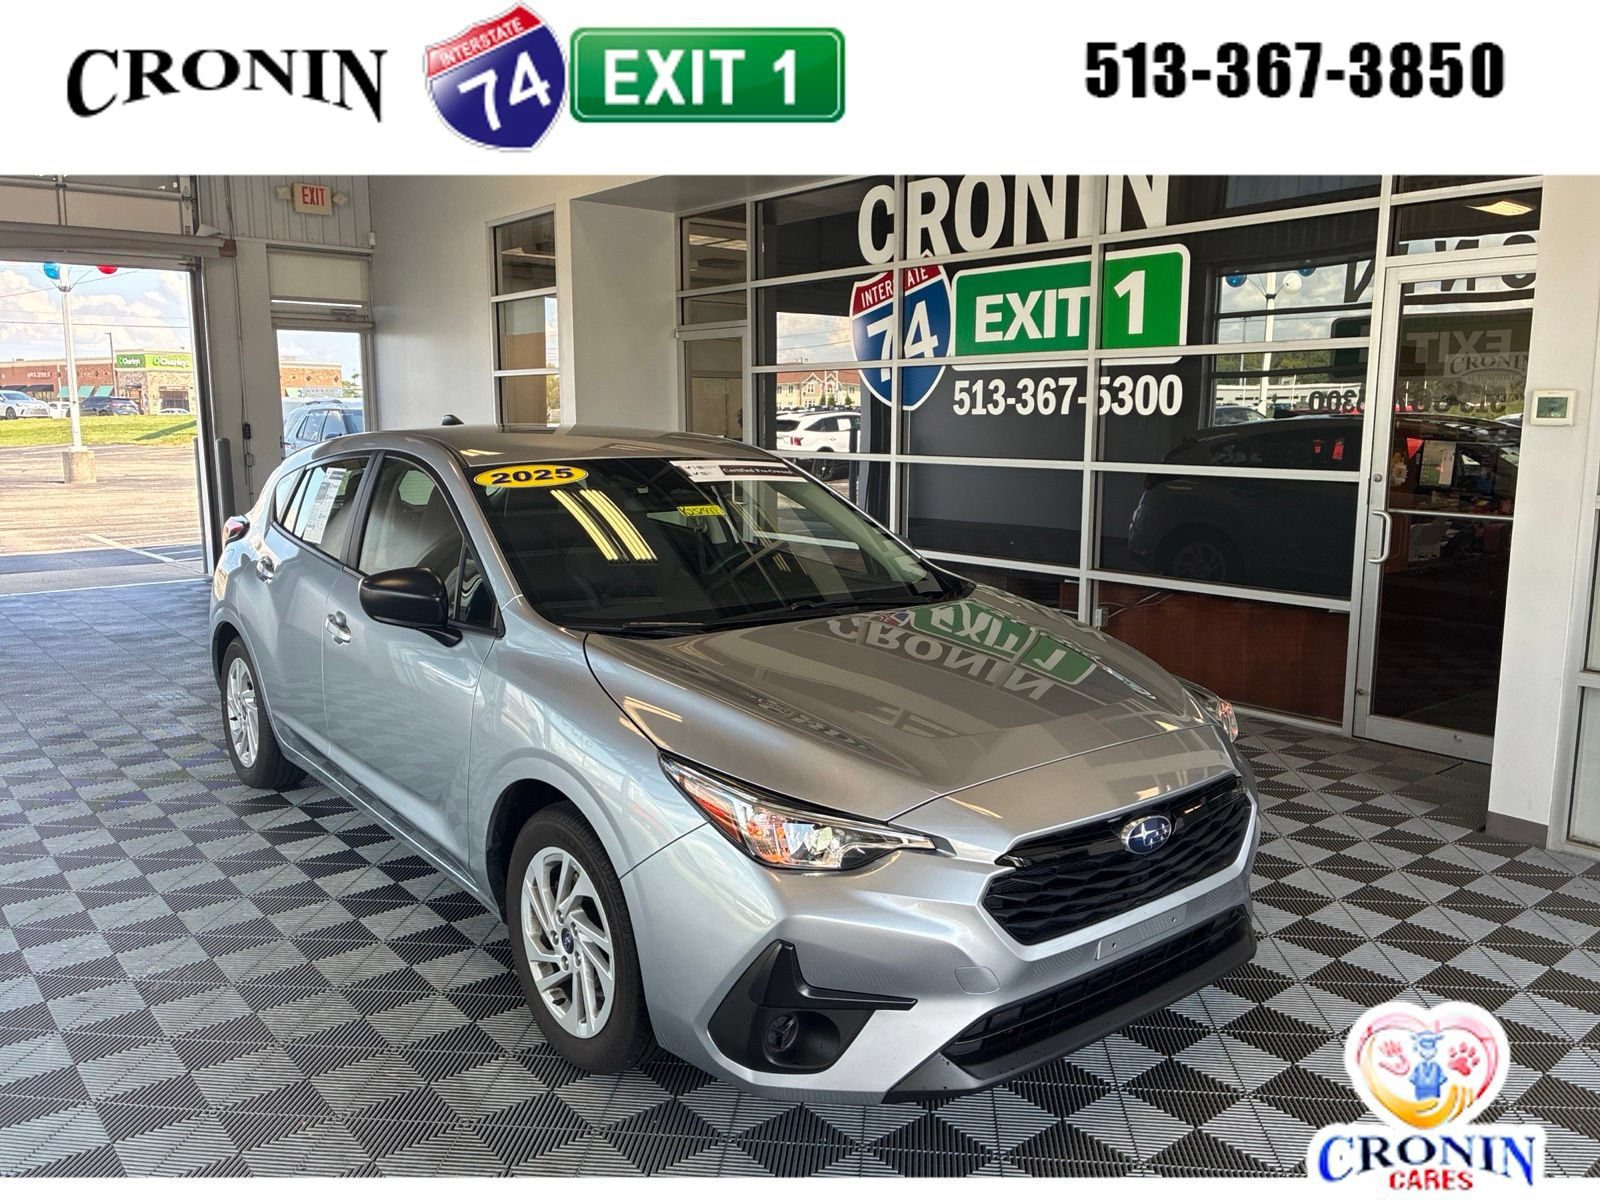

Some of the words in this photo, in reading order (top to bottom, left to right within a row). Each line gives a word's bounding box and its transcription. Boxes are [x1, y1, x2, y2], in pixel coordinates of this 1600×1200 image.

[301, 185, 326, 207] EXIT
[858, 174, 1167, 265] CRONIN
[861, 267, 929, 308] INTERATE
[975, 285, 1091, 343] EXIT
[1113, 270, 1146, 336] 1
[867, 299, 939, 383] 74
[953, 374, 1184, 417] 513-367-5300
[490, 468, 575, 485] 2025
